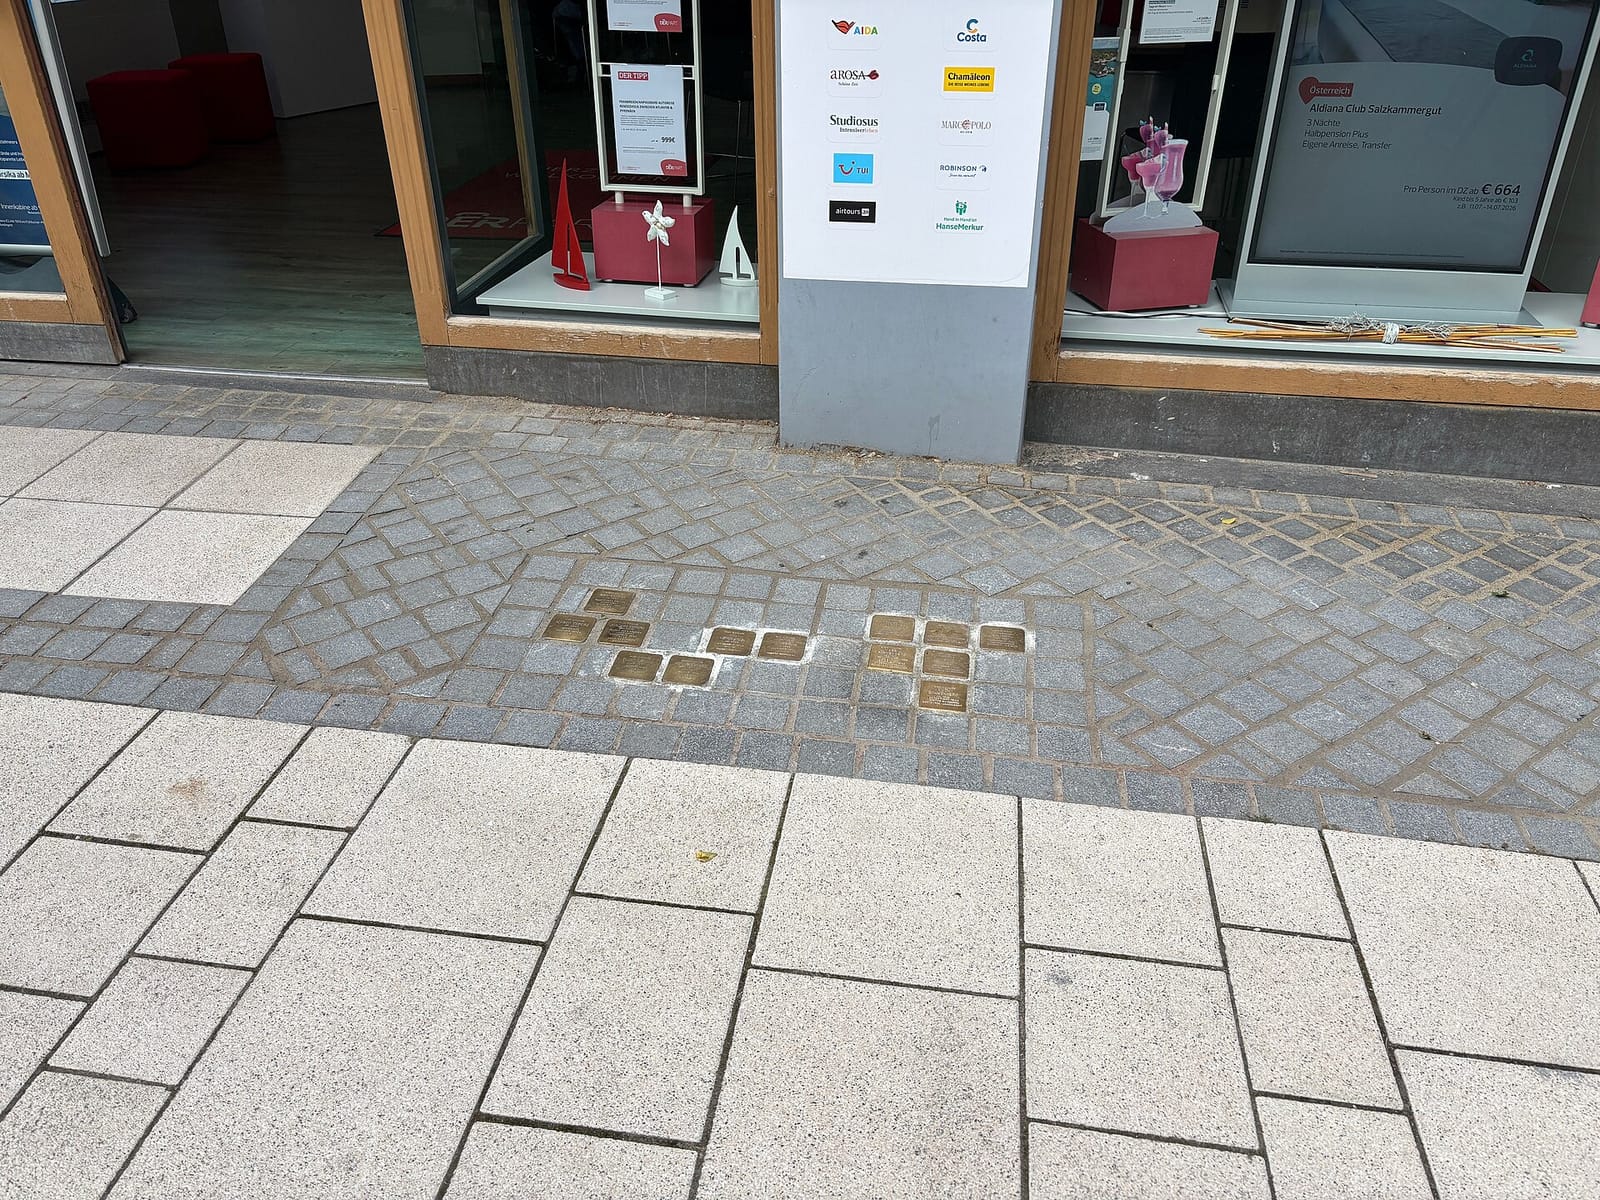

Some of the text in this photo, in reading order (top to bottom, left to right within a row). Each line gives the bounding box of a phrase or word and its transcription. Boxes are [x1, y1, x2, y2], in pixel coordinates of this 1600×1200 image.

[853, 25, 878, 36] AIDA
[957, 32, 987, 43] Costa
[618, 71, 648, 80] DER TIPP
[947, 72, 990, 82] Chamäleon
[1309, 84, 1351, 96] Österreich
[1309, 103, 1442, 117] Aldiana Club Salzkammergut
[829, 114, 879, 128] Studiosus
[1306, 118, 1341, 127] 3 Nächte
[1304, 129, 1369, 139] Halbpension Plus
[1302, 140, 1392, 150] Eigene Anreise, Transfer
[856, 167, 869, 175] TUI
[939, 164, 977, 172] ROBINSON
[1403, 185, 1417, 193] Pro
[1419, 185, 1446, 194] Person
[1446, 186, 1456, 194] im
[1469, 187, 1479, 195] ab
[1481, 184, 1492, 195] €
[1494, 184, 1521, 196] 664
[835, 207, 861, 216] airtours
[935, 222, 984, 231] HanseMerkur
